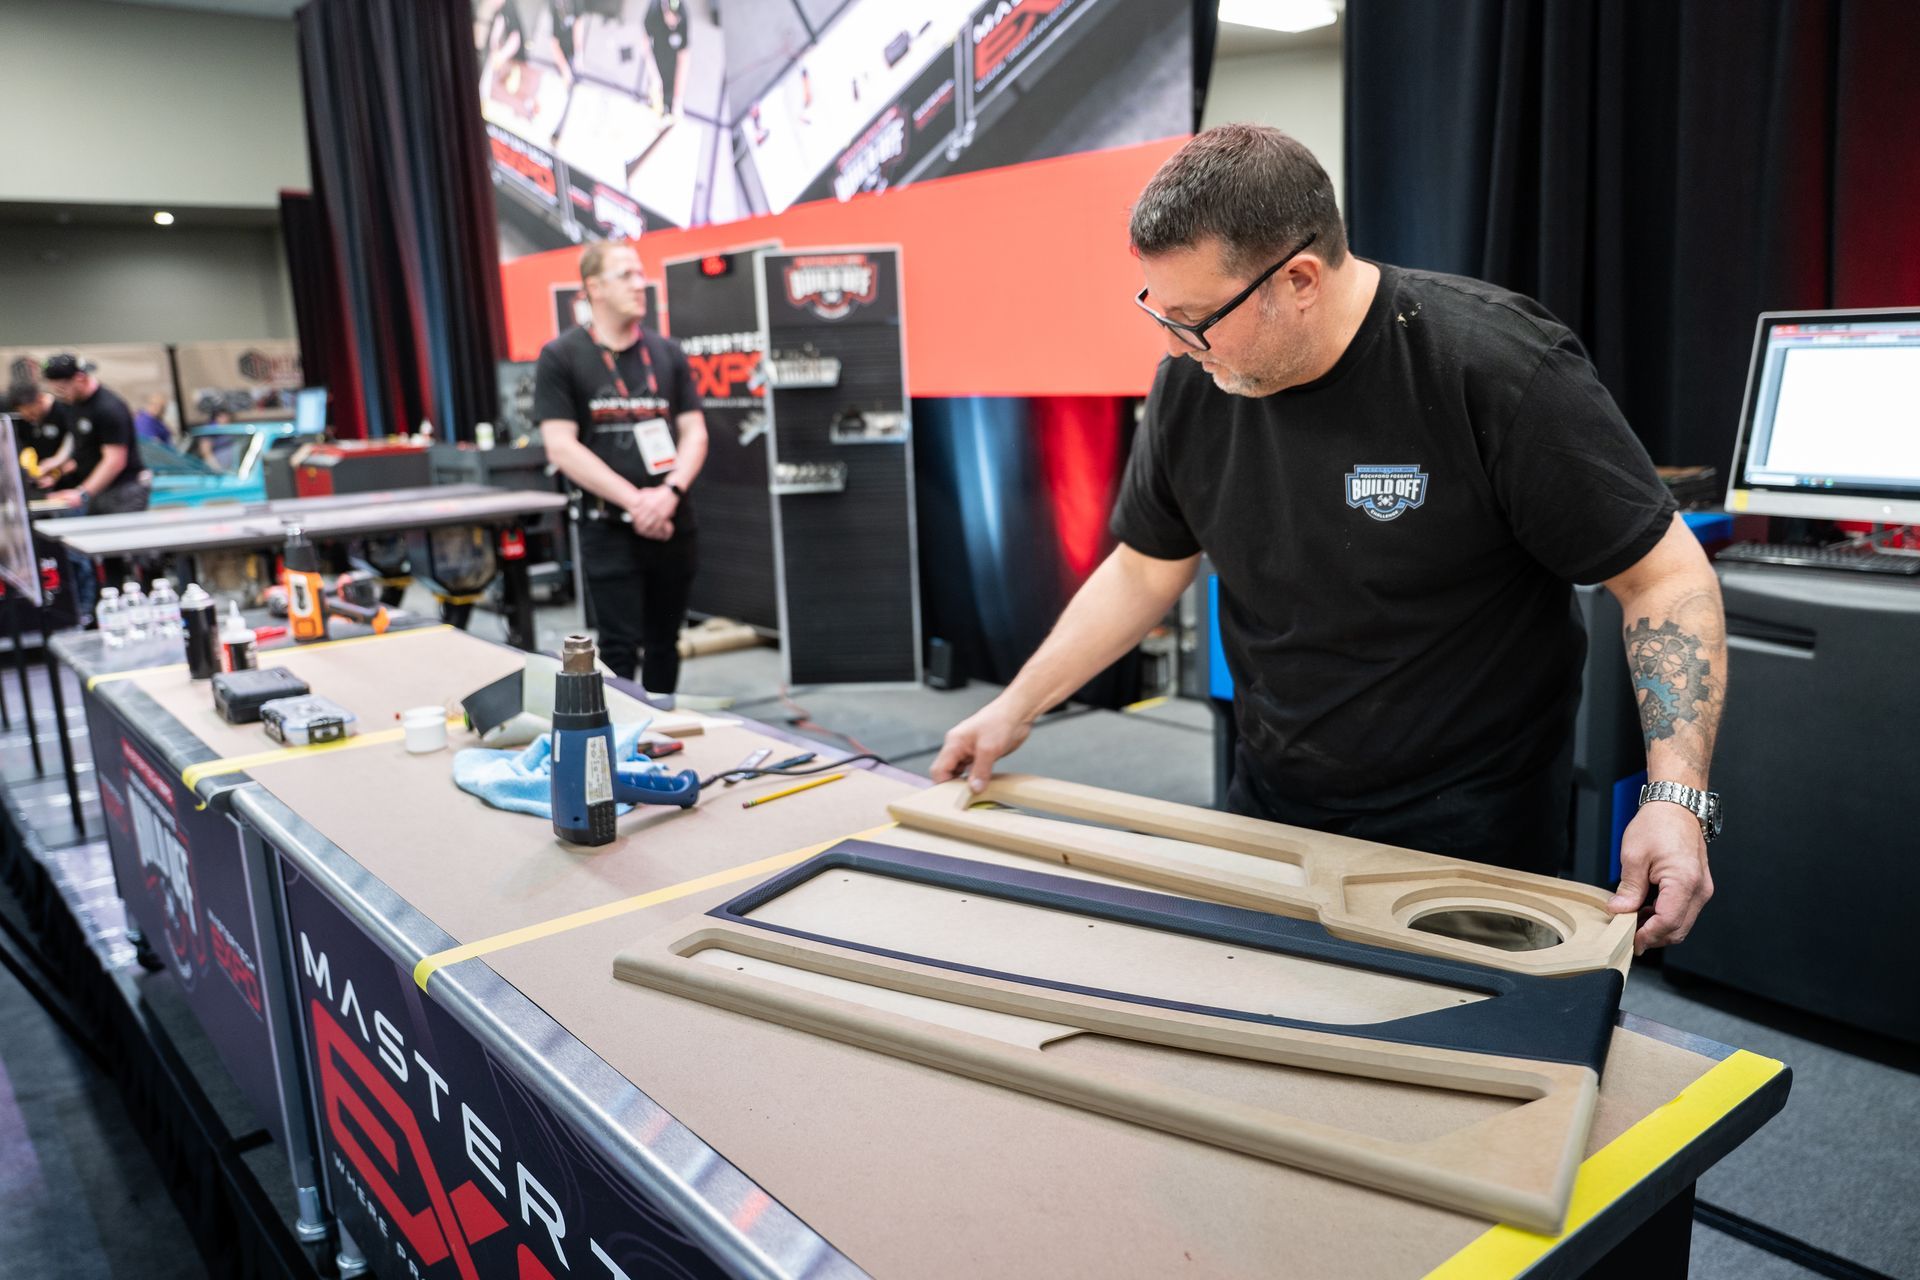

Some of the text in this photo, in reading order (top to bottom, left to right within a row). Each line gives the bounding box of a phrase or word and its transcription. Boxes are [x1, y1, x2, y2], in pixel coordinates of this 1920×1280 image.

[1352, 479, 1421, 500] BUILD OFF
[1370, 509, 1399, 519] CHALLENGE
[311, 998, 557, 1280] EX
[332, 1150, 426, 1280] WHERE PR
